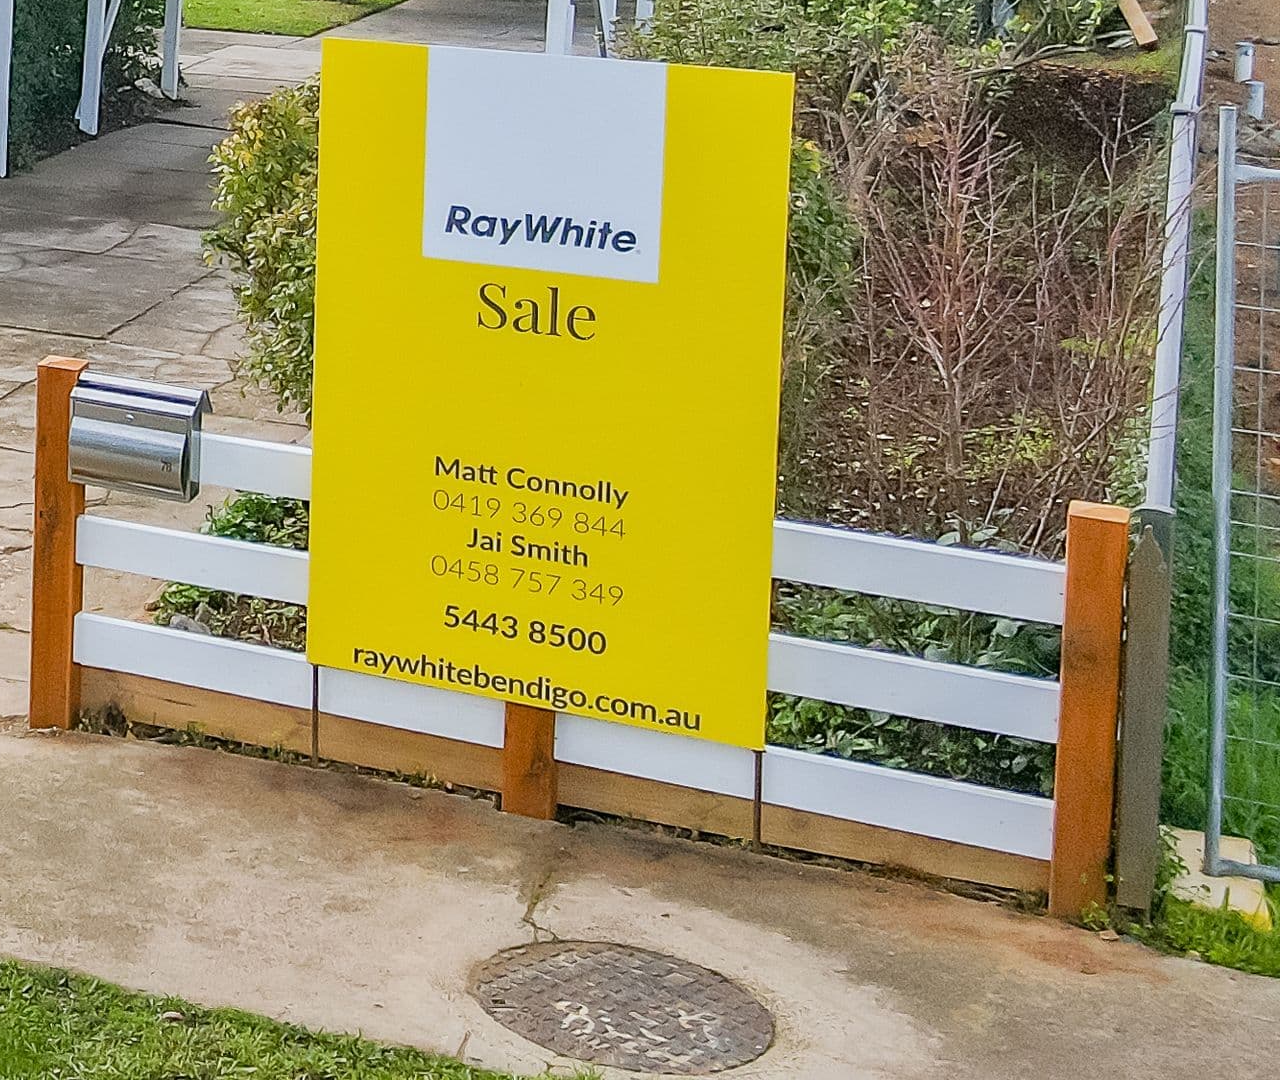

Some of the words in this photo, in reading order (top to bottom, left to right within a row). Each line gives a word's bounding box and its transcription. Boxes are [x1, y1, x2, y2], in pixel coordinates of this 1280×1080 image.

[445, 205, 637, 253] RayWhite
[477, 282, 596, 341] Sale
[434, 455, 498, 486] Matt
[506, 467, 630, 510] Connolly
[432, 488, 502, 520] 0419
[511, 501, 563, 530] 369
[573, 511, 627, 540] 844
[466, 527, 503, 553] Jai
[510, 534, 589, 569] Smith
[430, 554, 500, 587] 0458
[509, 567, 562, 596] 757
[571, 578, 625, 607] 349
[443, 604, 519, 639] 5443
[528, 620, 608, 655] 8500
[353, 647, 702, 732] raywhitebendigo.com.au
